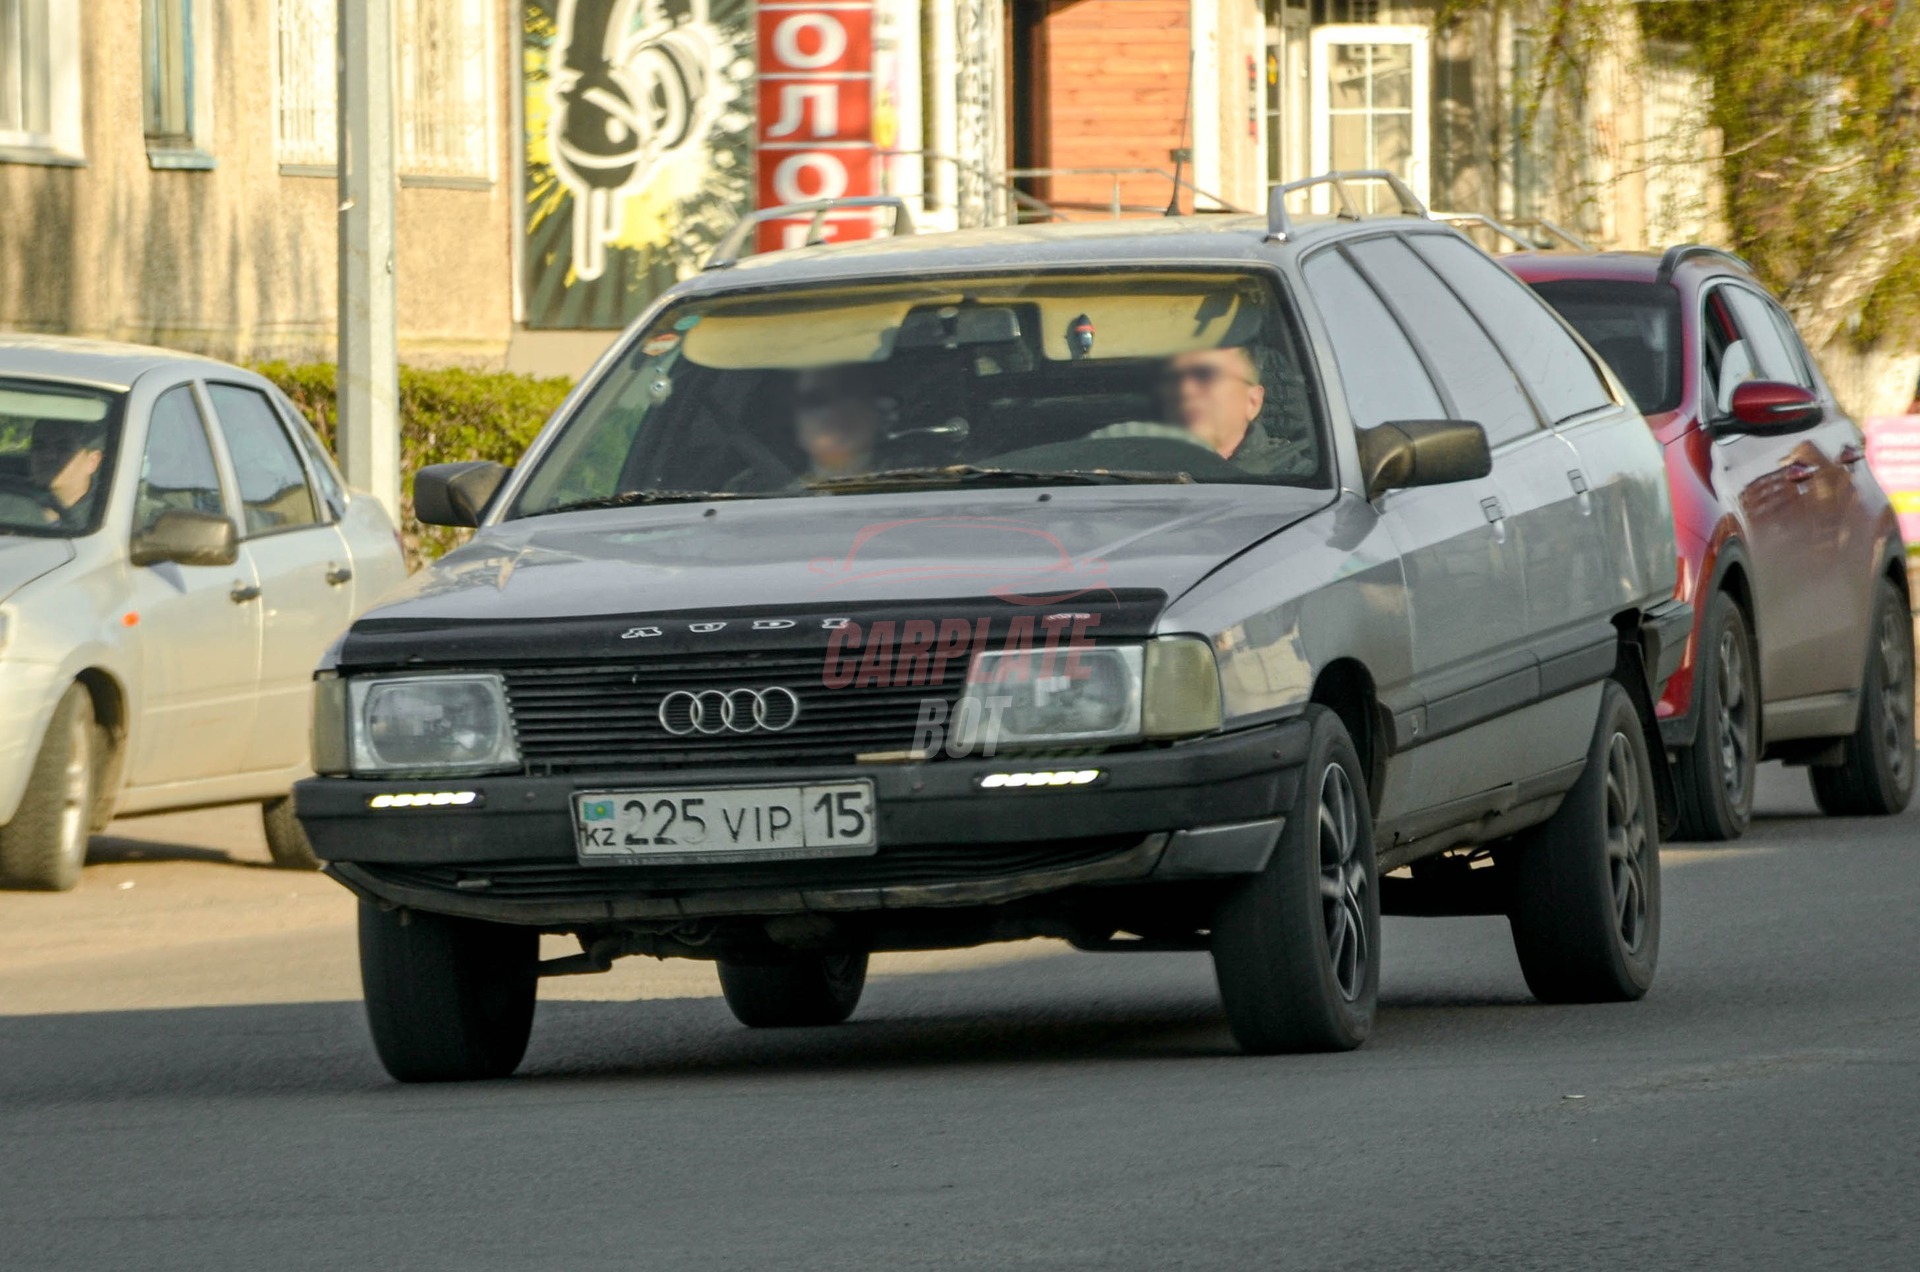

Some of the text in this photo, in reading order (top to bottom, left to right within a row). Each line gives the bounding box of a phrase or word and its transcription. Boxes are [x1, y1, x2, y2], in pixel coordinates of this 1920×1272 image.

[621, 618, 851, 639] AUDI
[623, 791, 865, 845] 225 VIP 15
[584, 827, 617, 847] KZ
